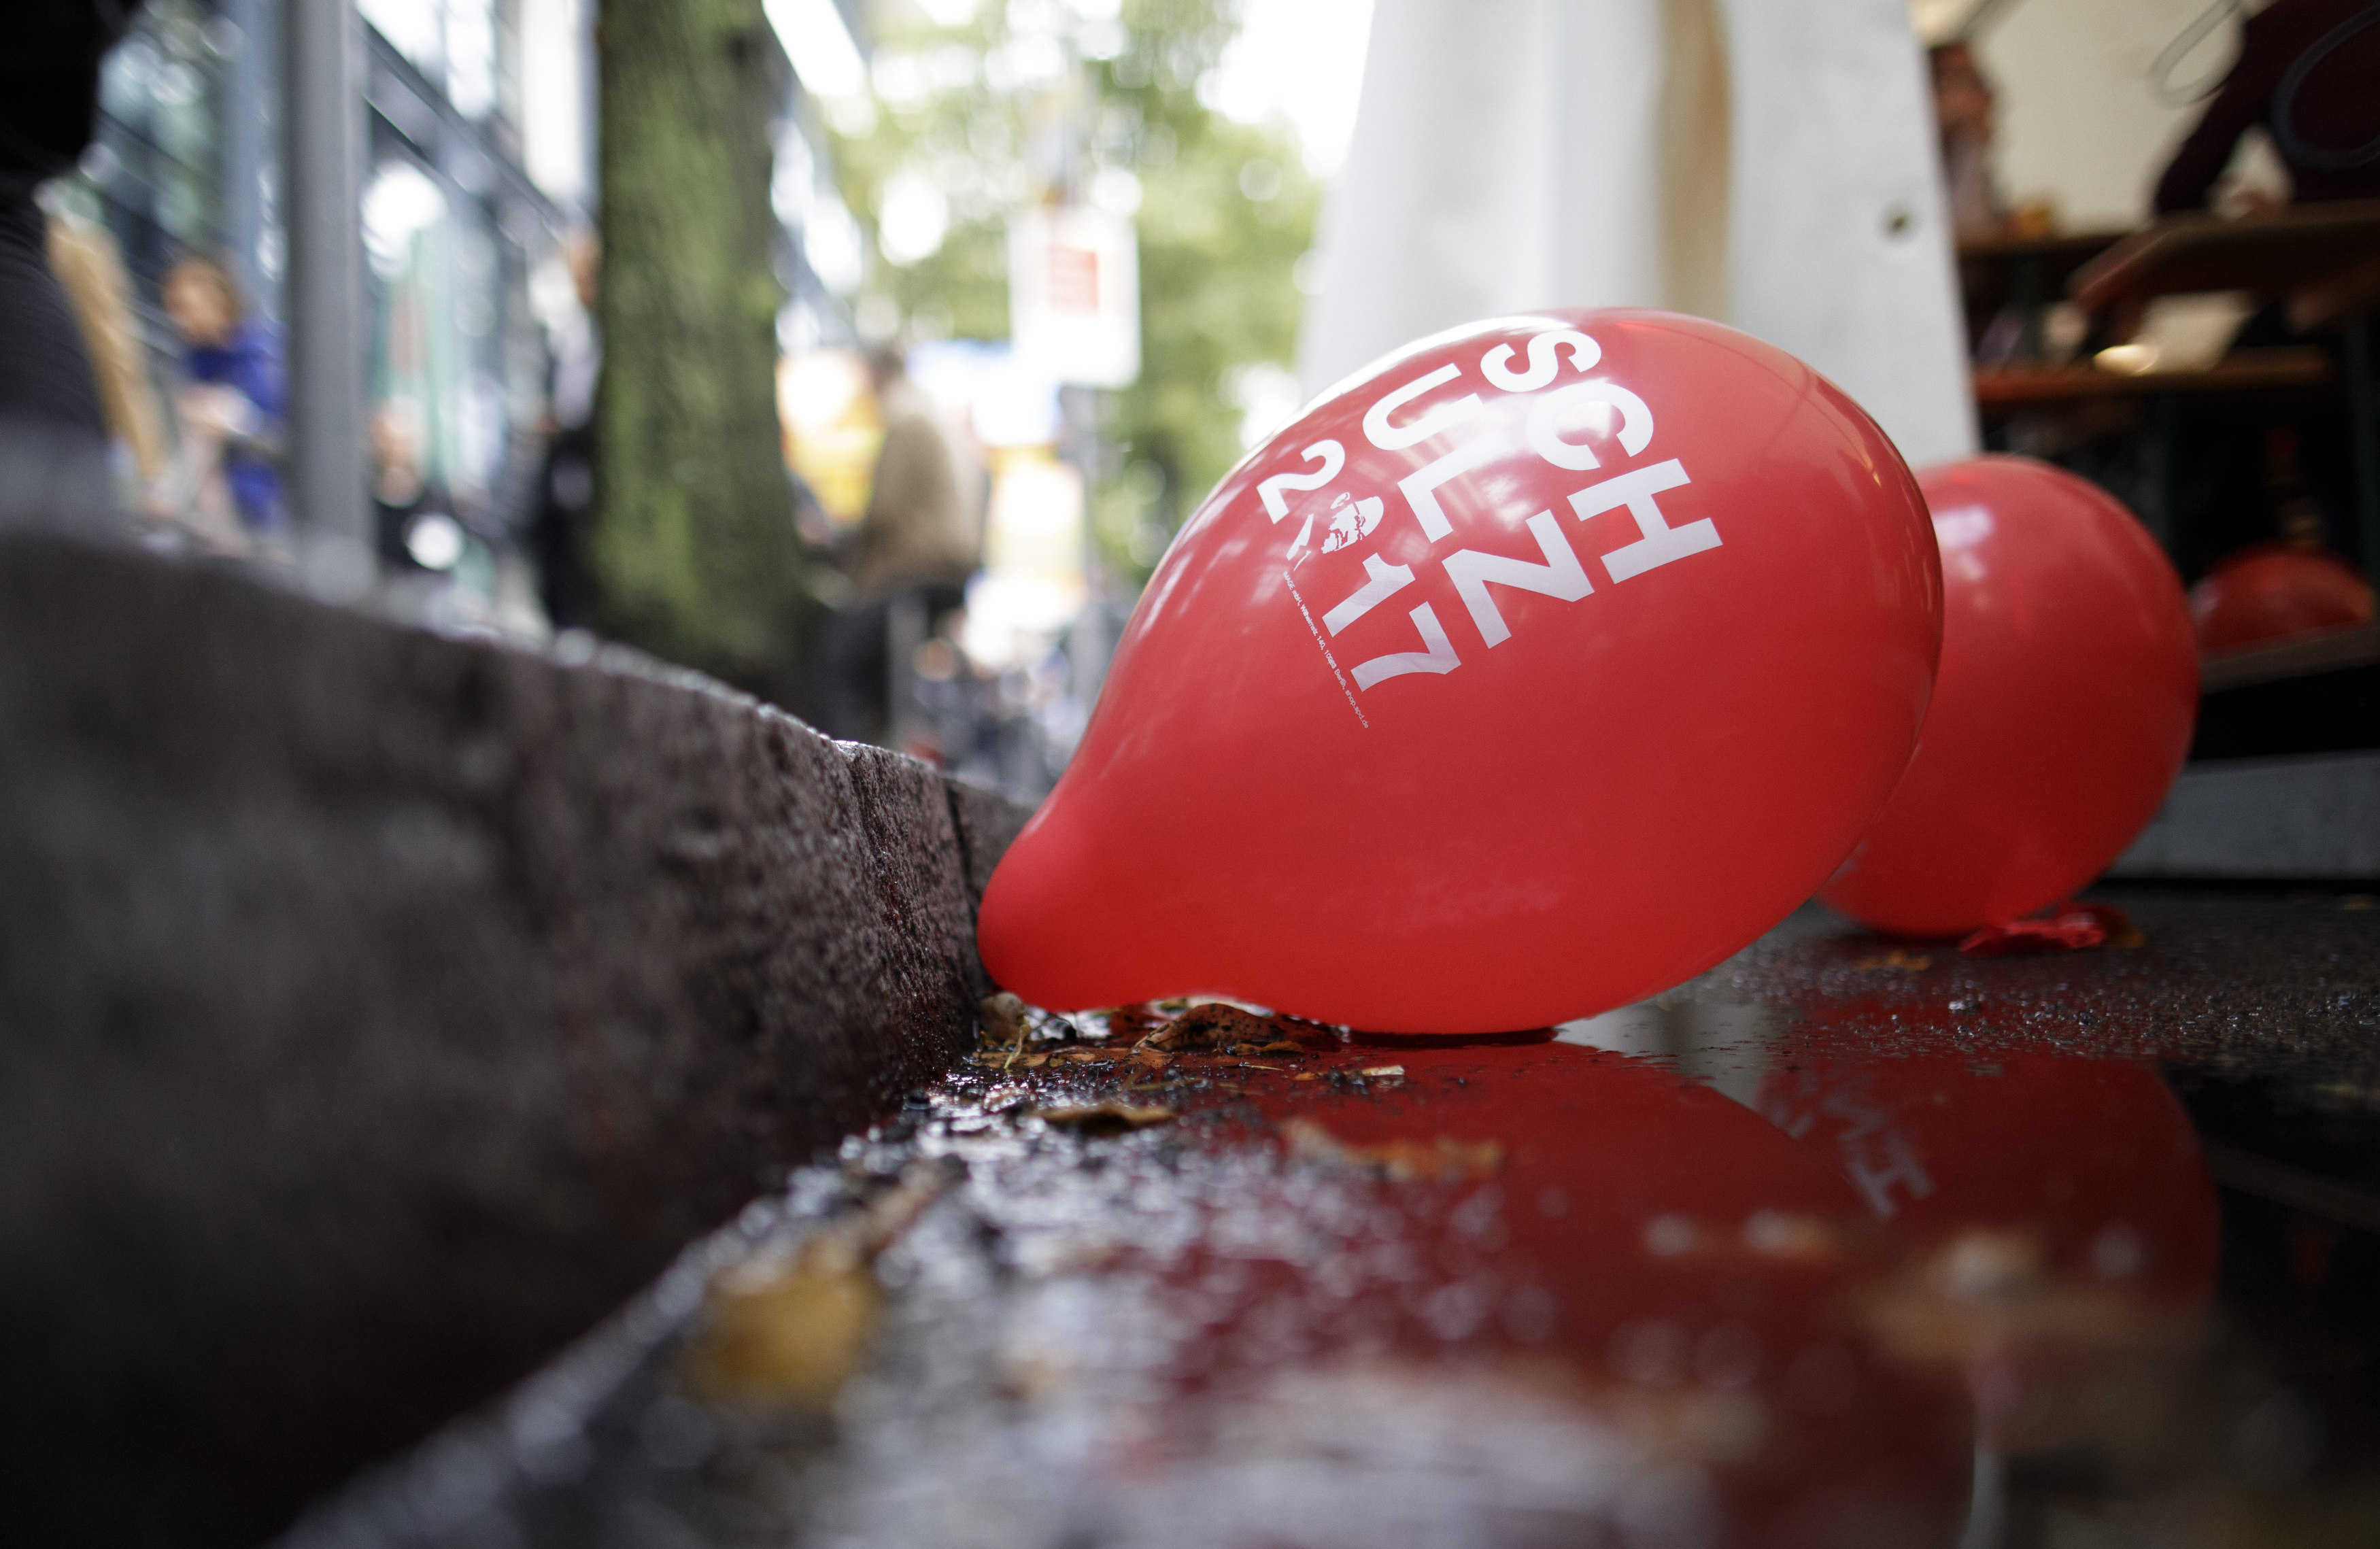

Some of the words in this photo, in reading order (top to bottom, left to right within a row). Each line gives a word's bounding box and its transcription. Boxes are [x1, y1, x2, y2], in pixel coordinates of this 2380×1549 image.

[1362, 362, 1595, 649] ULZ
[1480, 330, 1723, 585] SCH
[1316, 635, 1326, 650] 140,
[1345, 690, 1369, 728] shop.spd.de
